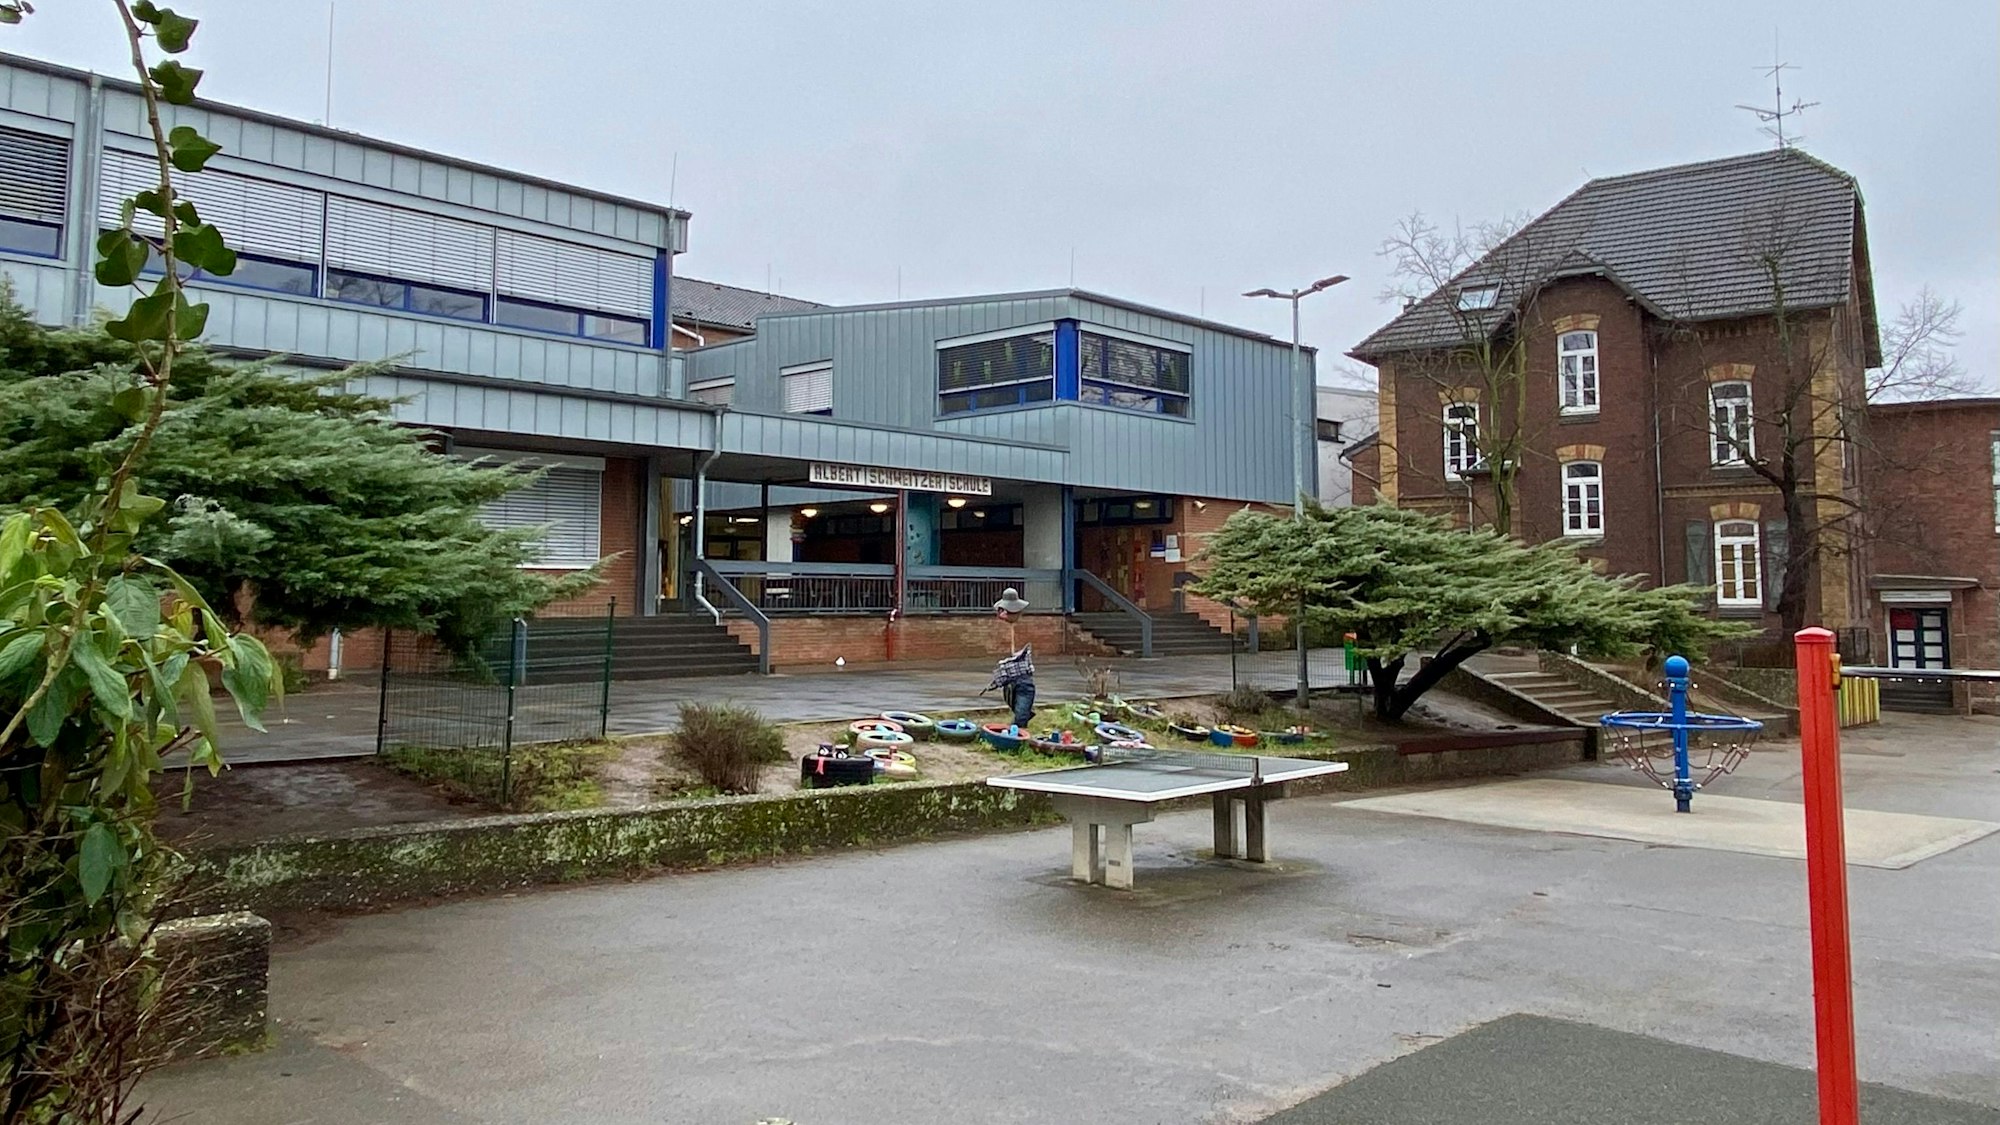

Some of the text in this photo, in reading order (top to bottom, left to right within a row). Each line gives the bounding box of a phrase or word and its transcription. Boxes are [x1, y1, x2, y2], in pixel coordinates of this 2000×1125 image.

[814, 464, 989, 493] ALBERT SCHWEITZER SCHULE
